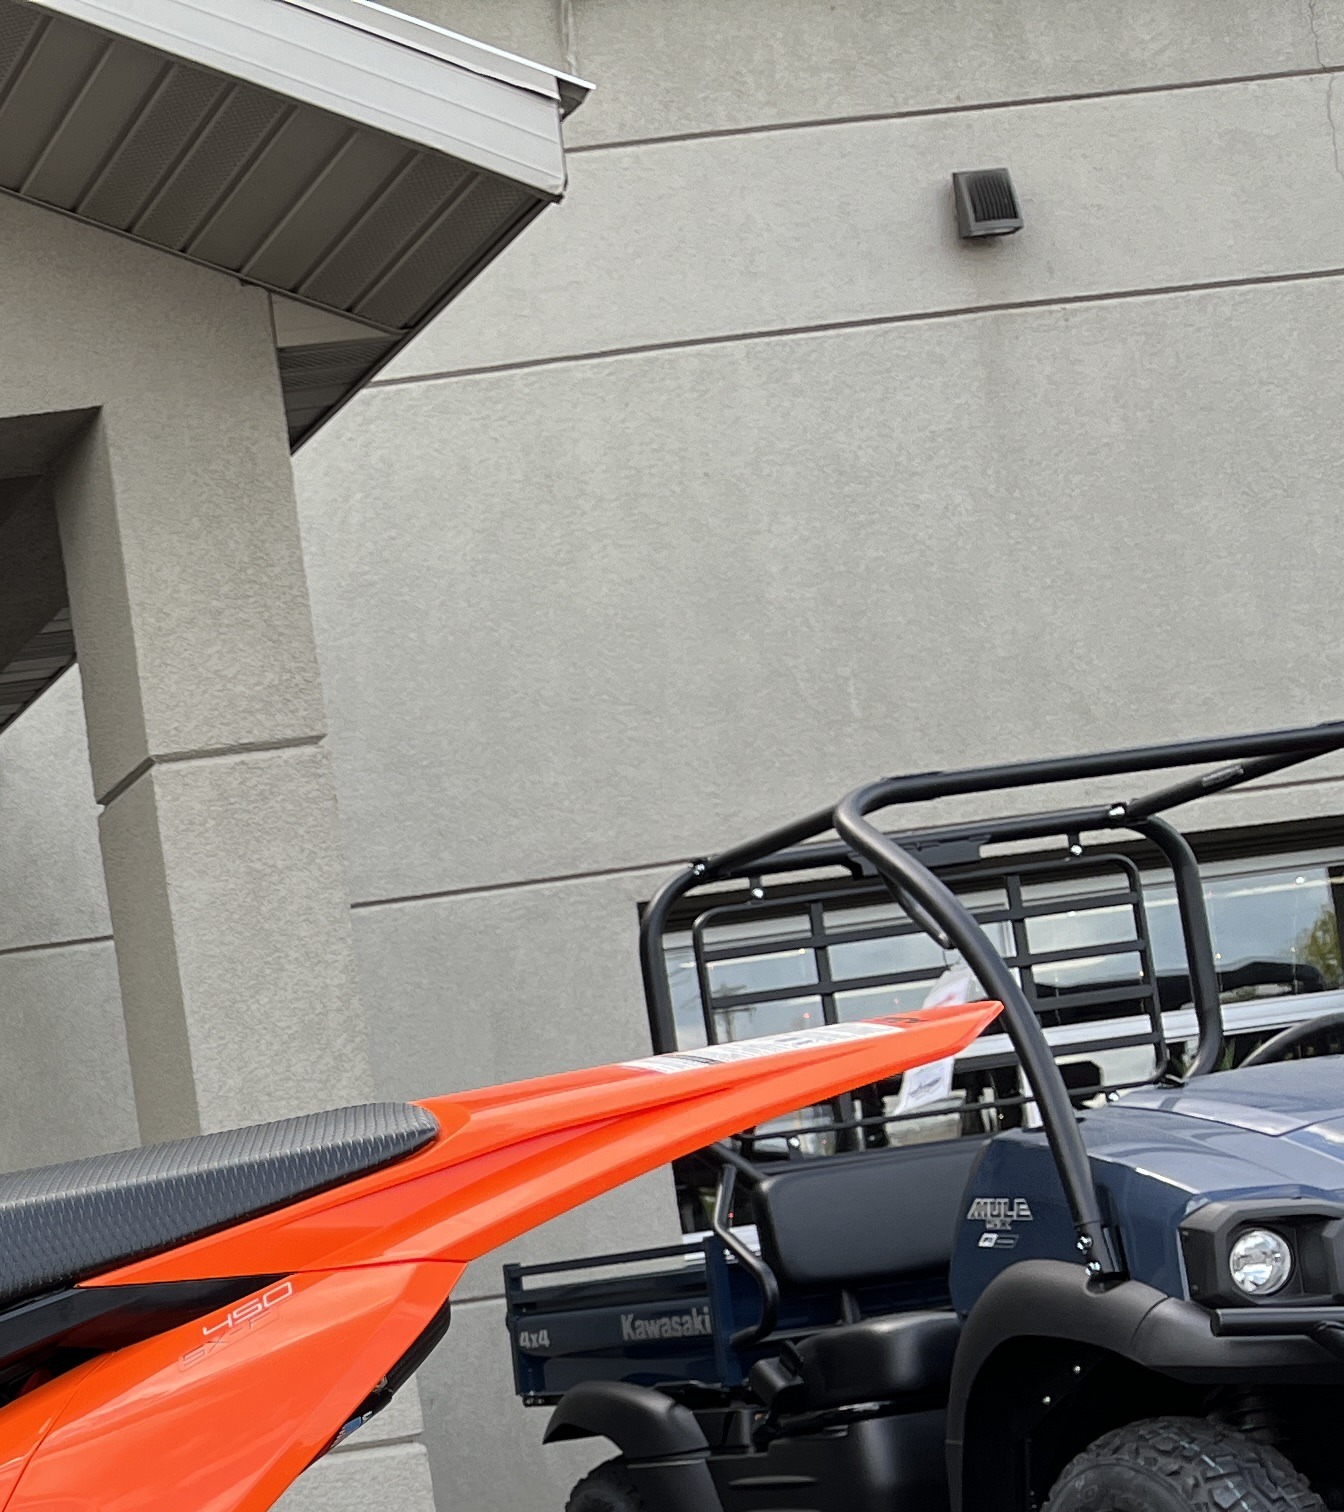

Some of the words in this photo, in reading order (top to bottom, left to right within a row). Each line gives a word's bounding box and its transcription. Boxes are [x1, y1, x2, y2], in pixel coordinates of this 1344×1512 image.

[967, 1197, 1034, 1220] MULE
[201, 1281, 293, 1335] 450
[519, 1328, 551, 1349] 4x4
[620, 1305, 713, 1342] Kawasaki
